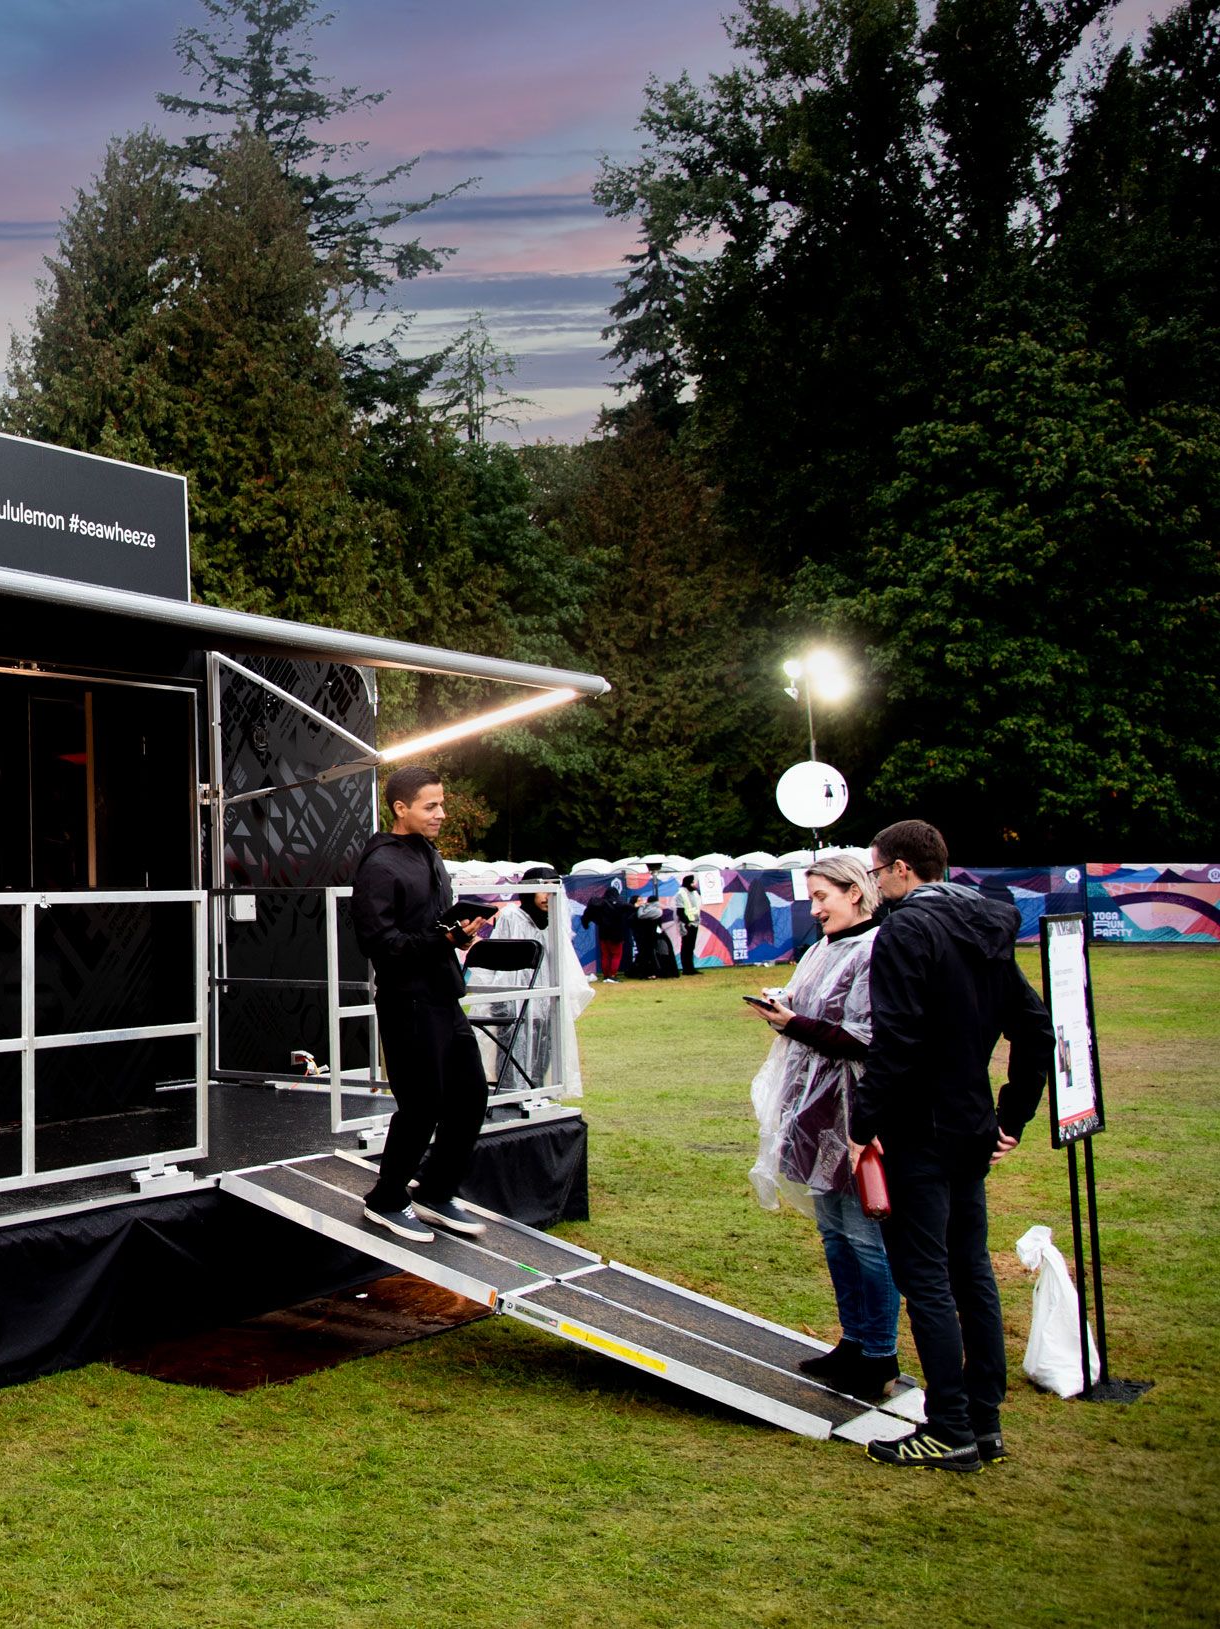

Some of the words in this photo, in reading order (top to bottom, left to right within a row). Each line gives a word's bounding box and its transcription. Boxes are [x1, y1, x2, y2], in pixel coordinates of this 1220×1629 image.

[68, 513, 156, 549] #seawheeze
[1092, 911, 1119, 920] YOGA
[1092, 920, 1125, 929] RUN
[1092, 928, 1133, 938] PARTY
